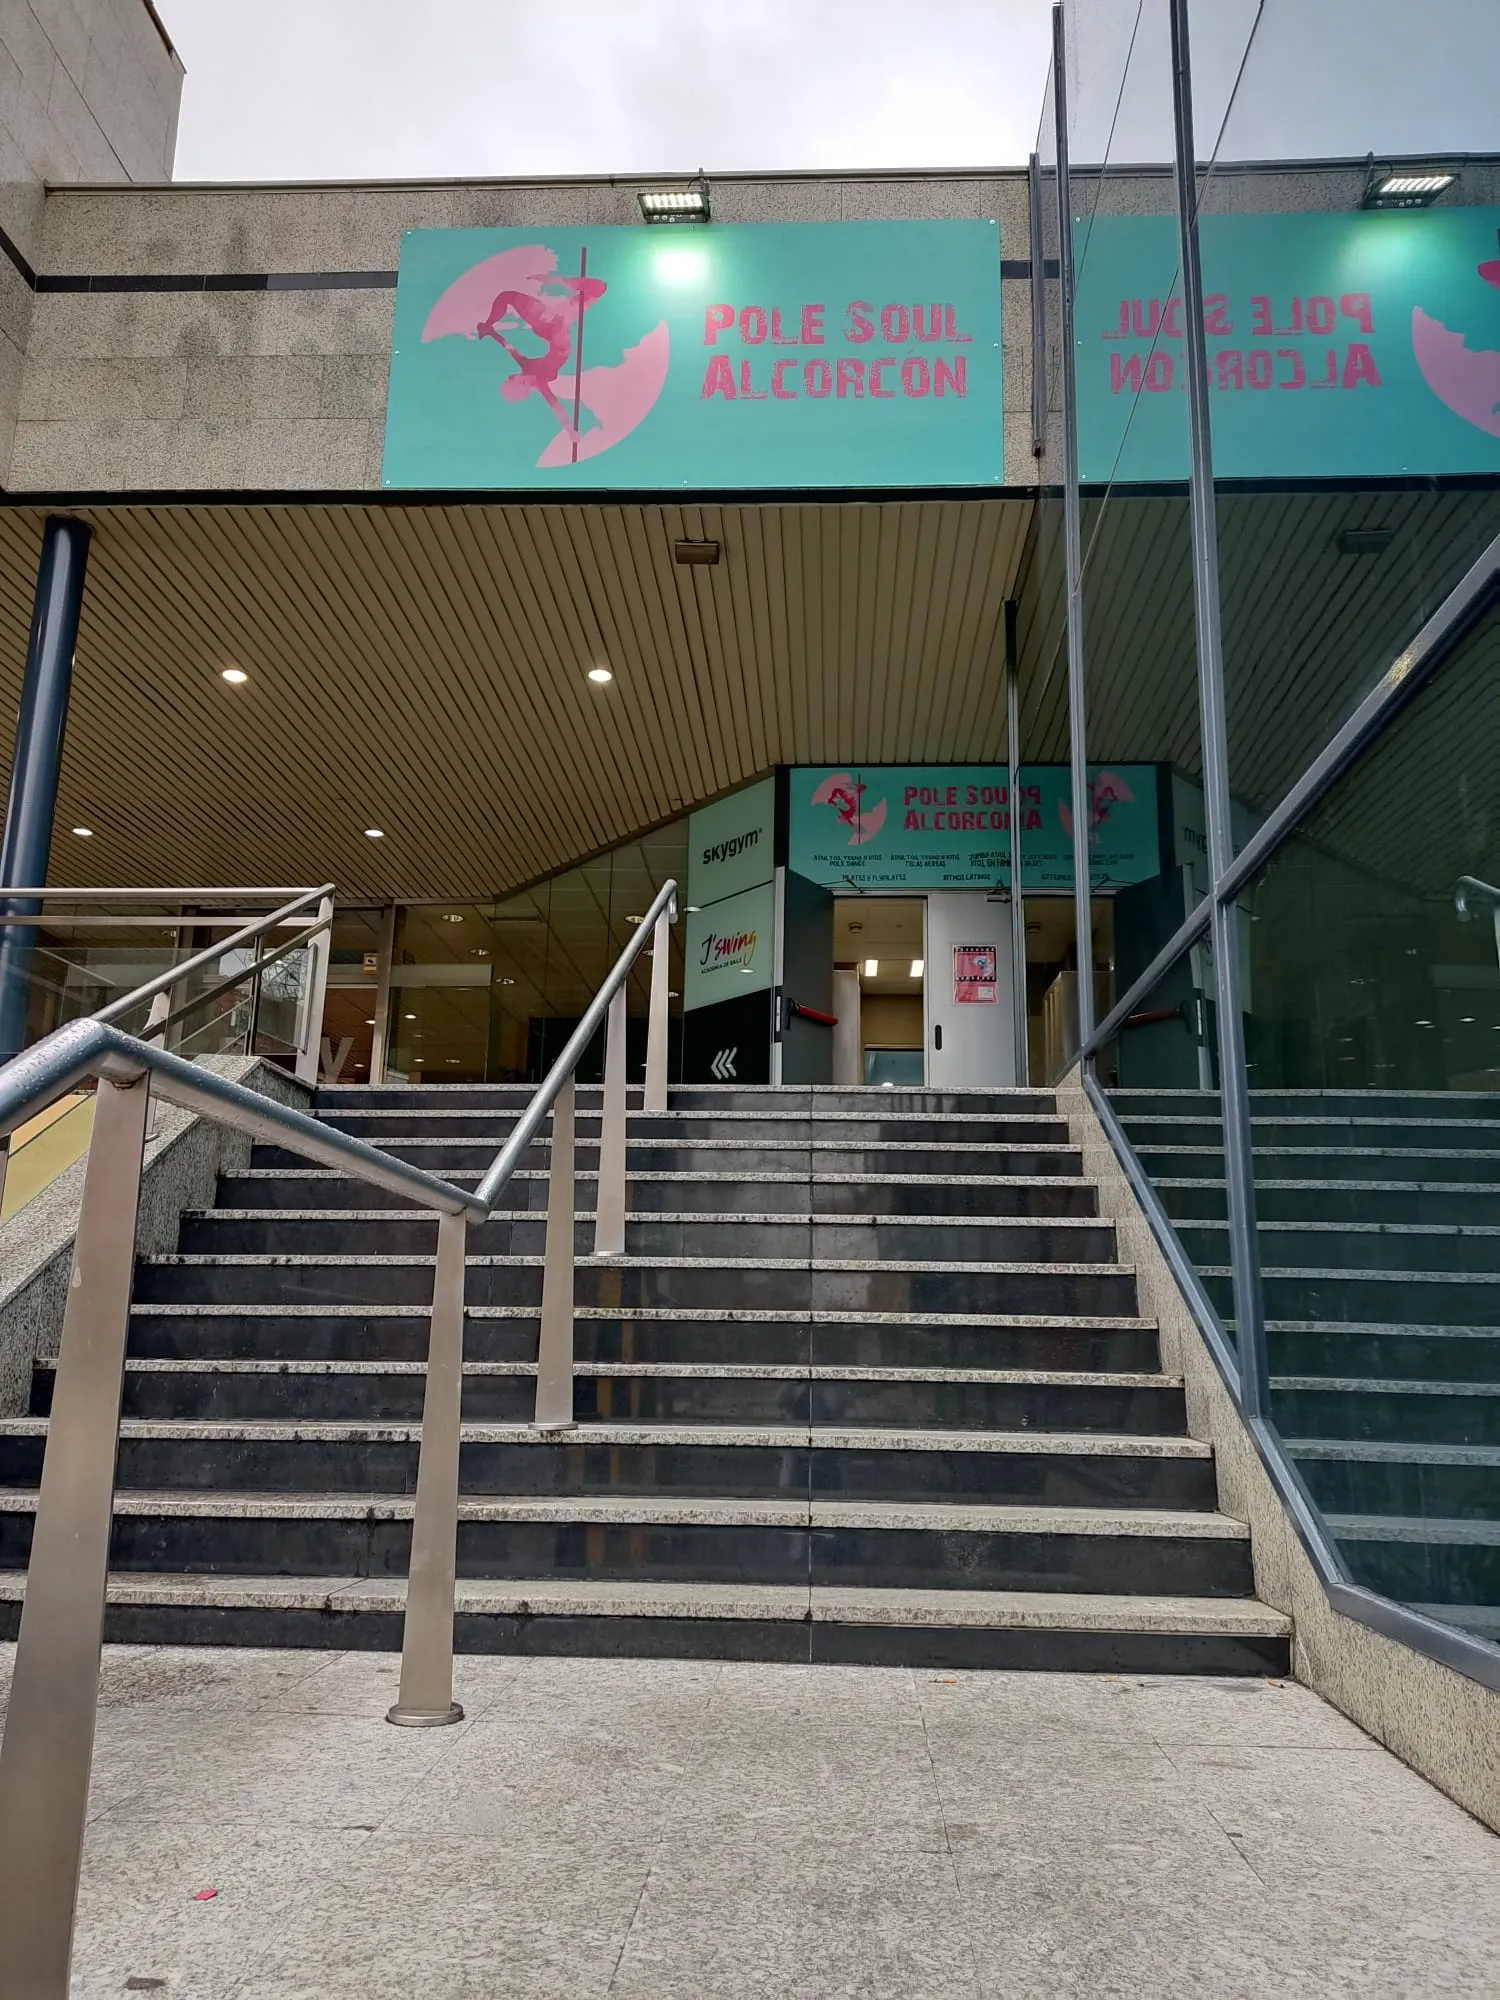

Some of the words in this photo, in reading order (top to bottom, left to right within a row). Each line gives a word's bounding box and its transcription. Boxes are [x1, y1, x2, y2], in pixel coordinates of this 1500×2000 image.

[703, 303, 825, 347] POLE
[843, 301, 974, 345] SOUL
[700, 349, 967, 401] ALCORCÓN
[904, 786, 957, 806] POLE
[965, 785, 1009, 806] SOU
